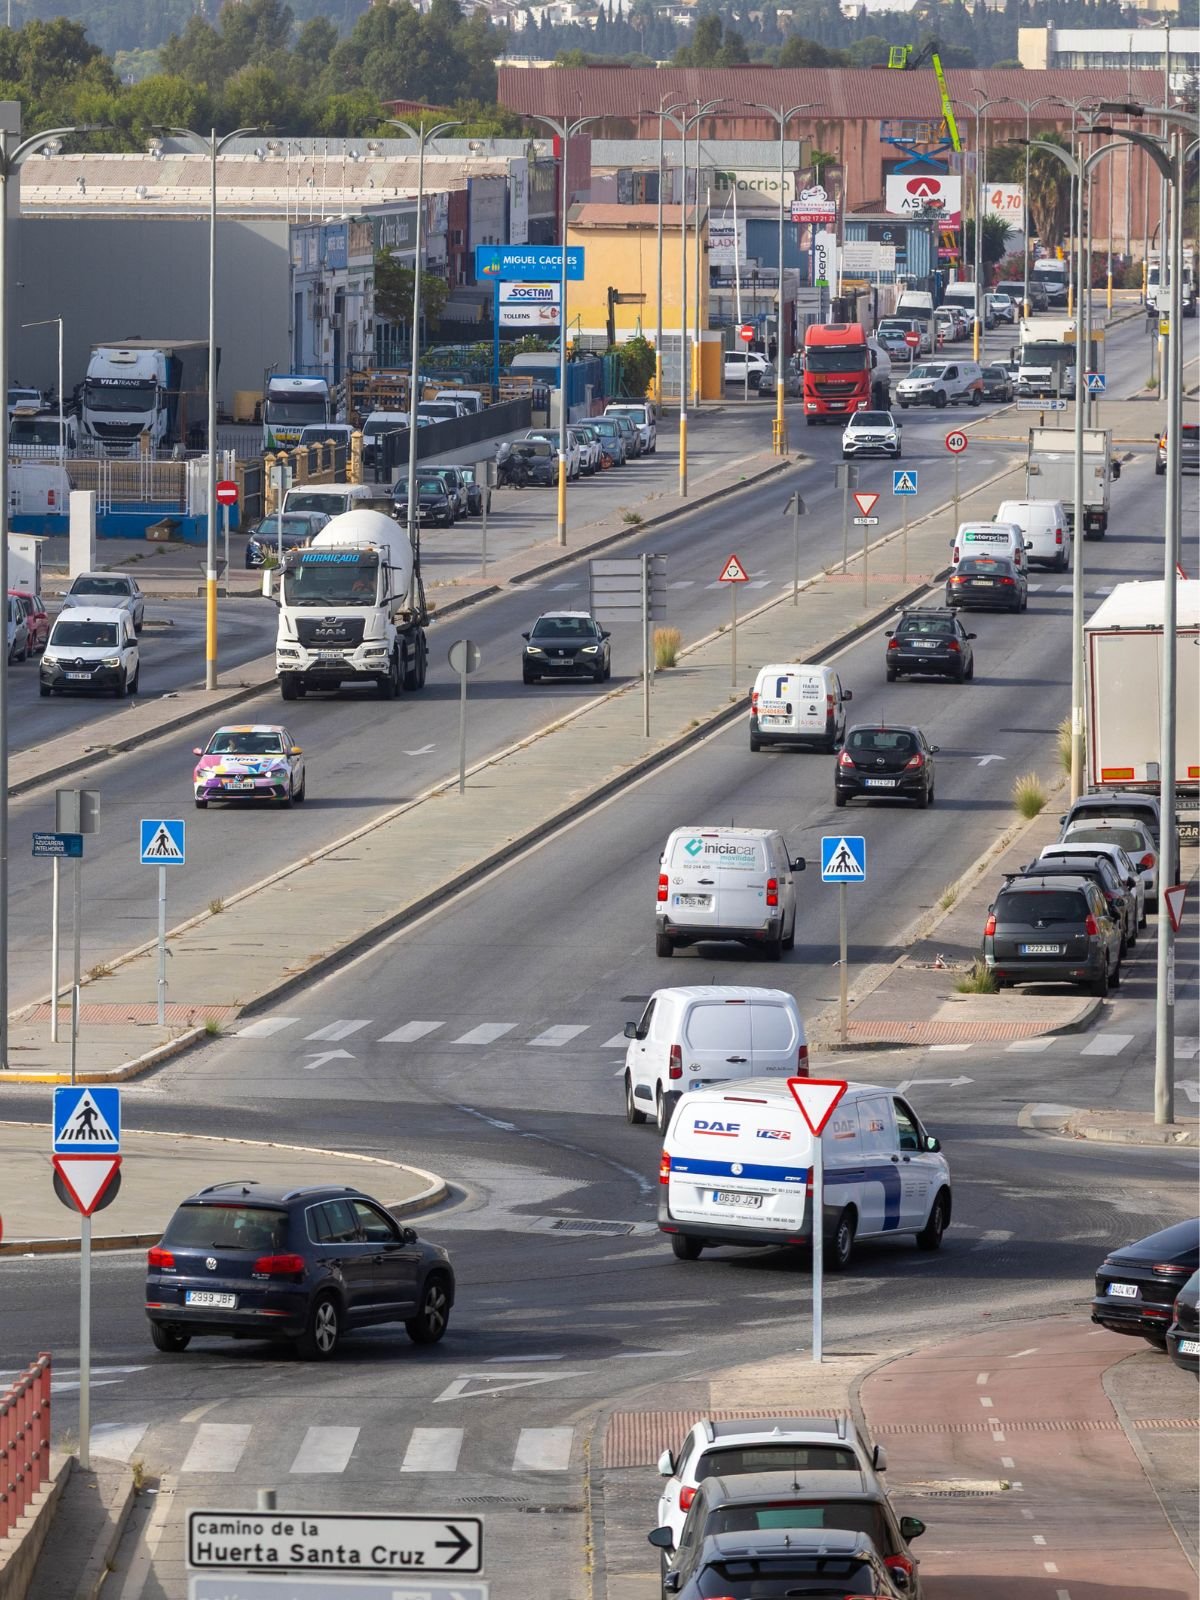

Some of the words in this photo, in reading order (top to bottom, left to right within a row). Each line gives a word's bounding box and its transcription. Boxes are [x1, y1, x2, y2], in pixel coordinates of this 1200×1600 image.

[991, 190, 1021, 210] 4,70
[503, 255, 537, 264] MIGUEL
[539, 256, 577, 265] CACEES
[816, 244, 827, 281] acero8
[509, 288, 553, 301] SOETAM
[100, 378, 140, 387] VILATRANS
[949, 437, 963, 447] 40
[704, 843, 755, 855] iniciacar
[693, 1120, 741, 1131] DAF
[833, 1120, 855, 1132] DAF
[719, 1193, 740, 1203] 0630
[192, 1292, 214, 1303] 2999
[216, 1294, 233, 1304] JBF
[197, 1521, 263, 1535] camino
[271, 1522, 294, 1536] de
[302, 1521, 318, 1536] la
[197, 1541, 279, 1562] Huerta
[289, 1543, 361, 1564] Santa
[371, 1545, 425, 1565] Cruz
